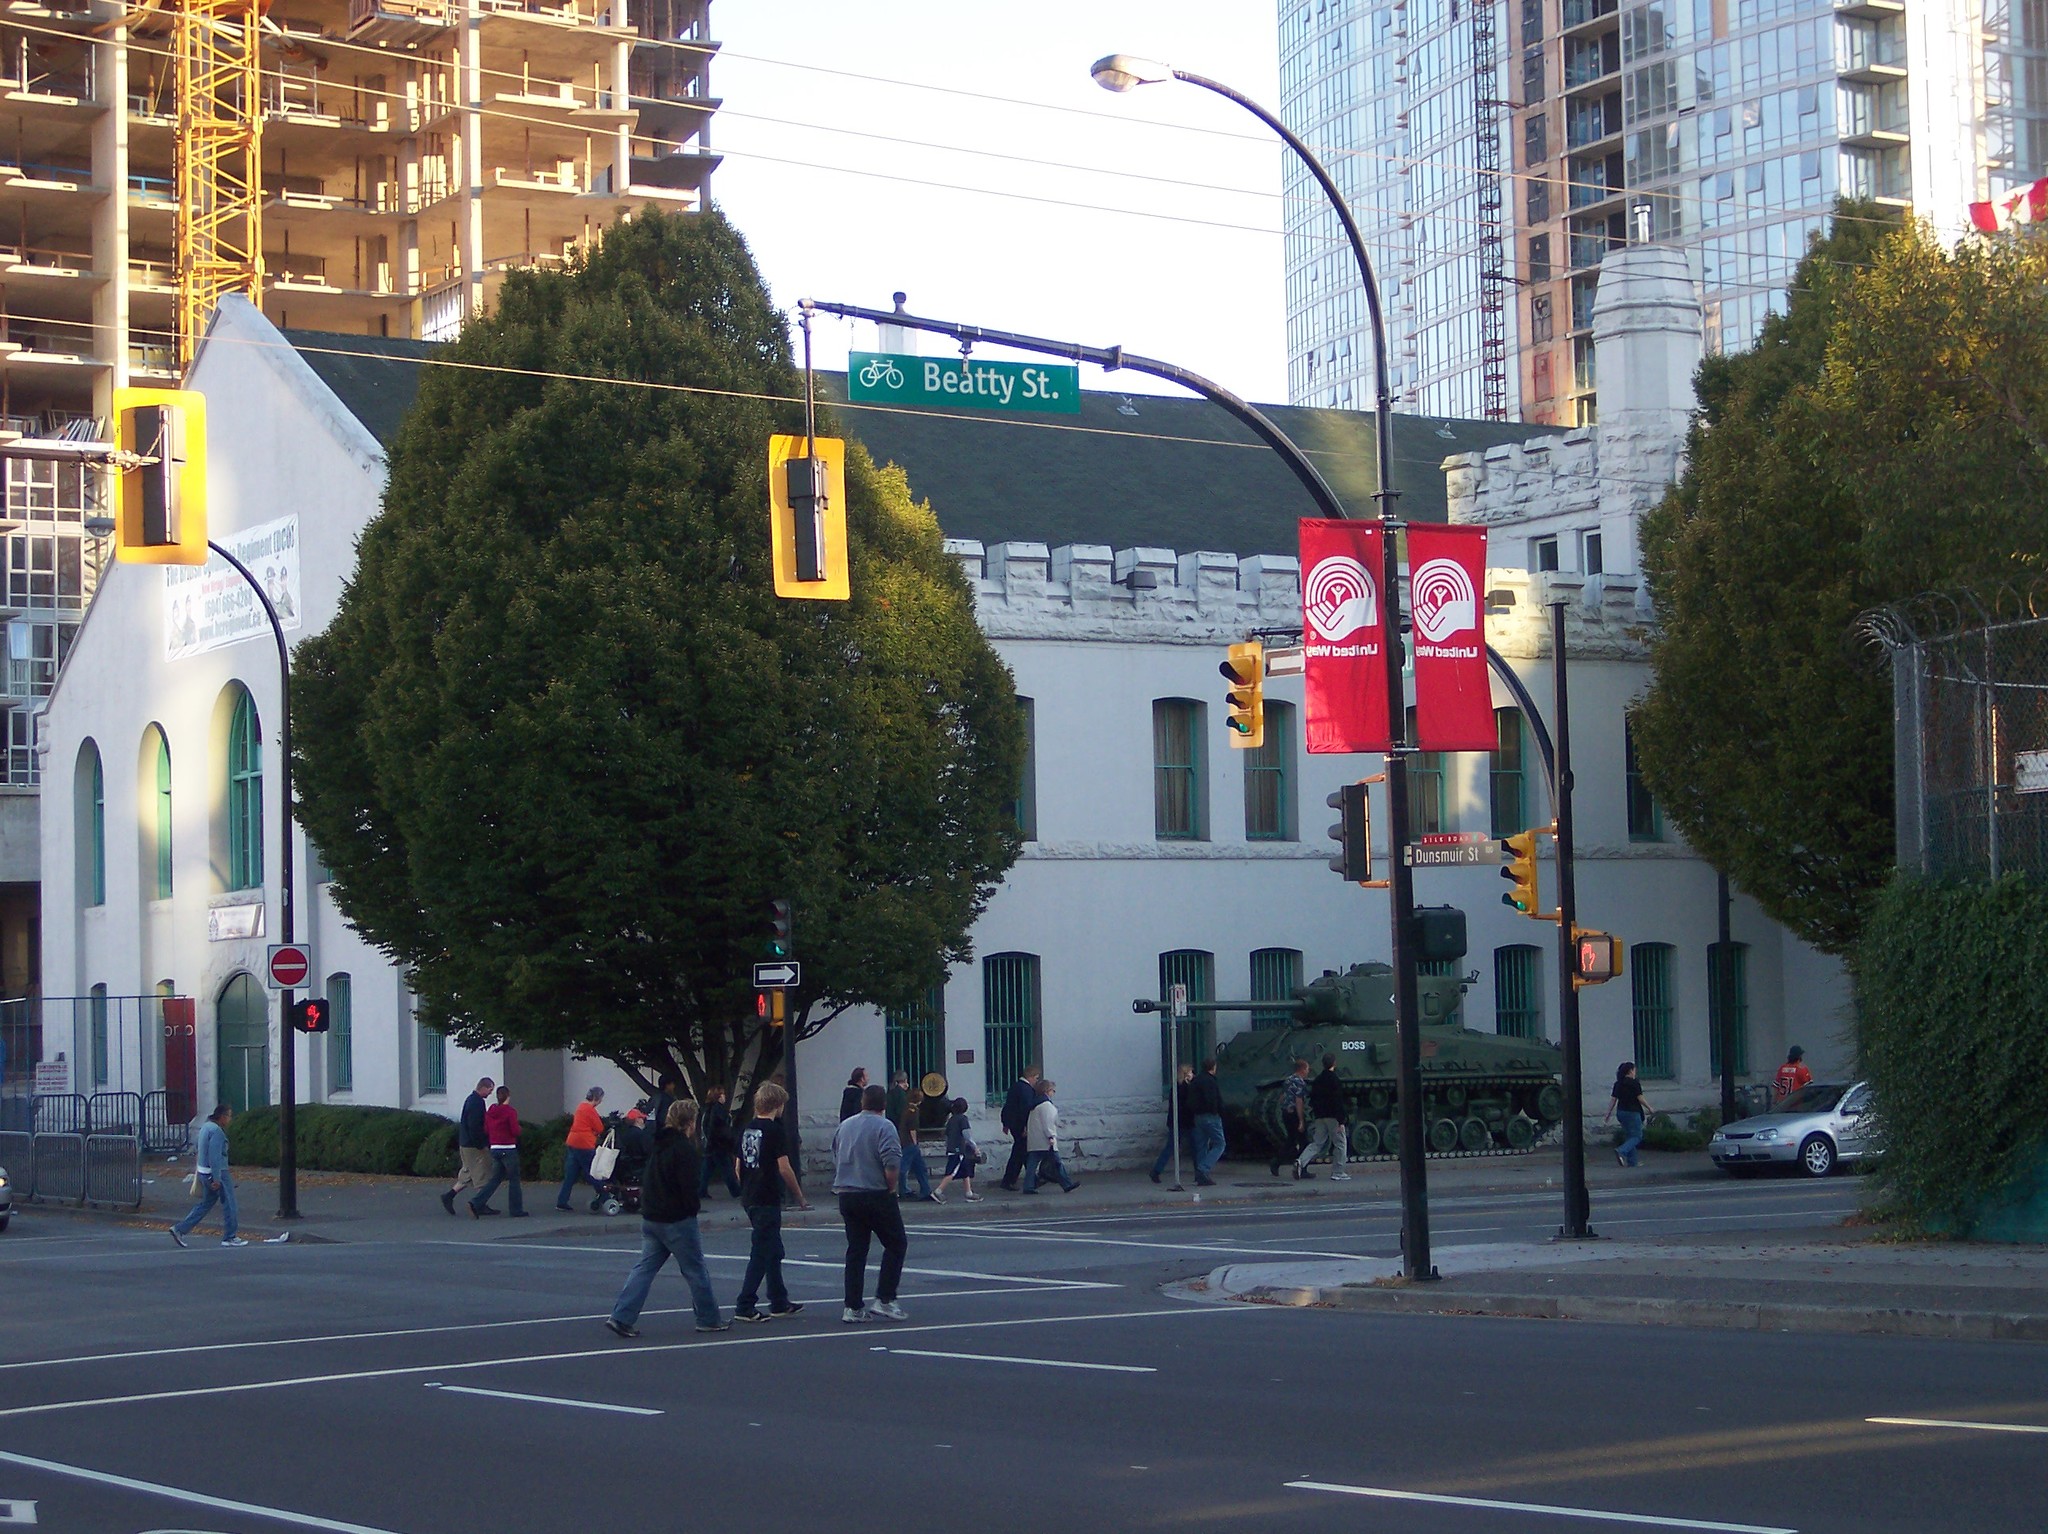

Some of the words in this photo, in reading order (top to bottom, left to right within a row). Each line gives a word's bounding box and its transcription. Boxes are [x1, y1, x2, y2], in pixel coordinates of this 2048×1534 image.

[924, 362, 1015, 404] Beatty
[1022, 369, 1059, 399] St.
[1423, 836, 1444, 844] SILK
[1415, 848, 1463, 863] Dunsmuir
[1468, 846, 1479, 862] St
[1341, 1041, 1366, 1050] BOSS
[1780, 1076, 1794, 1096] 51
